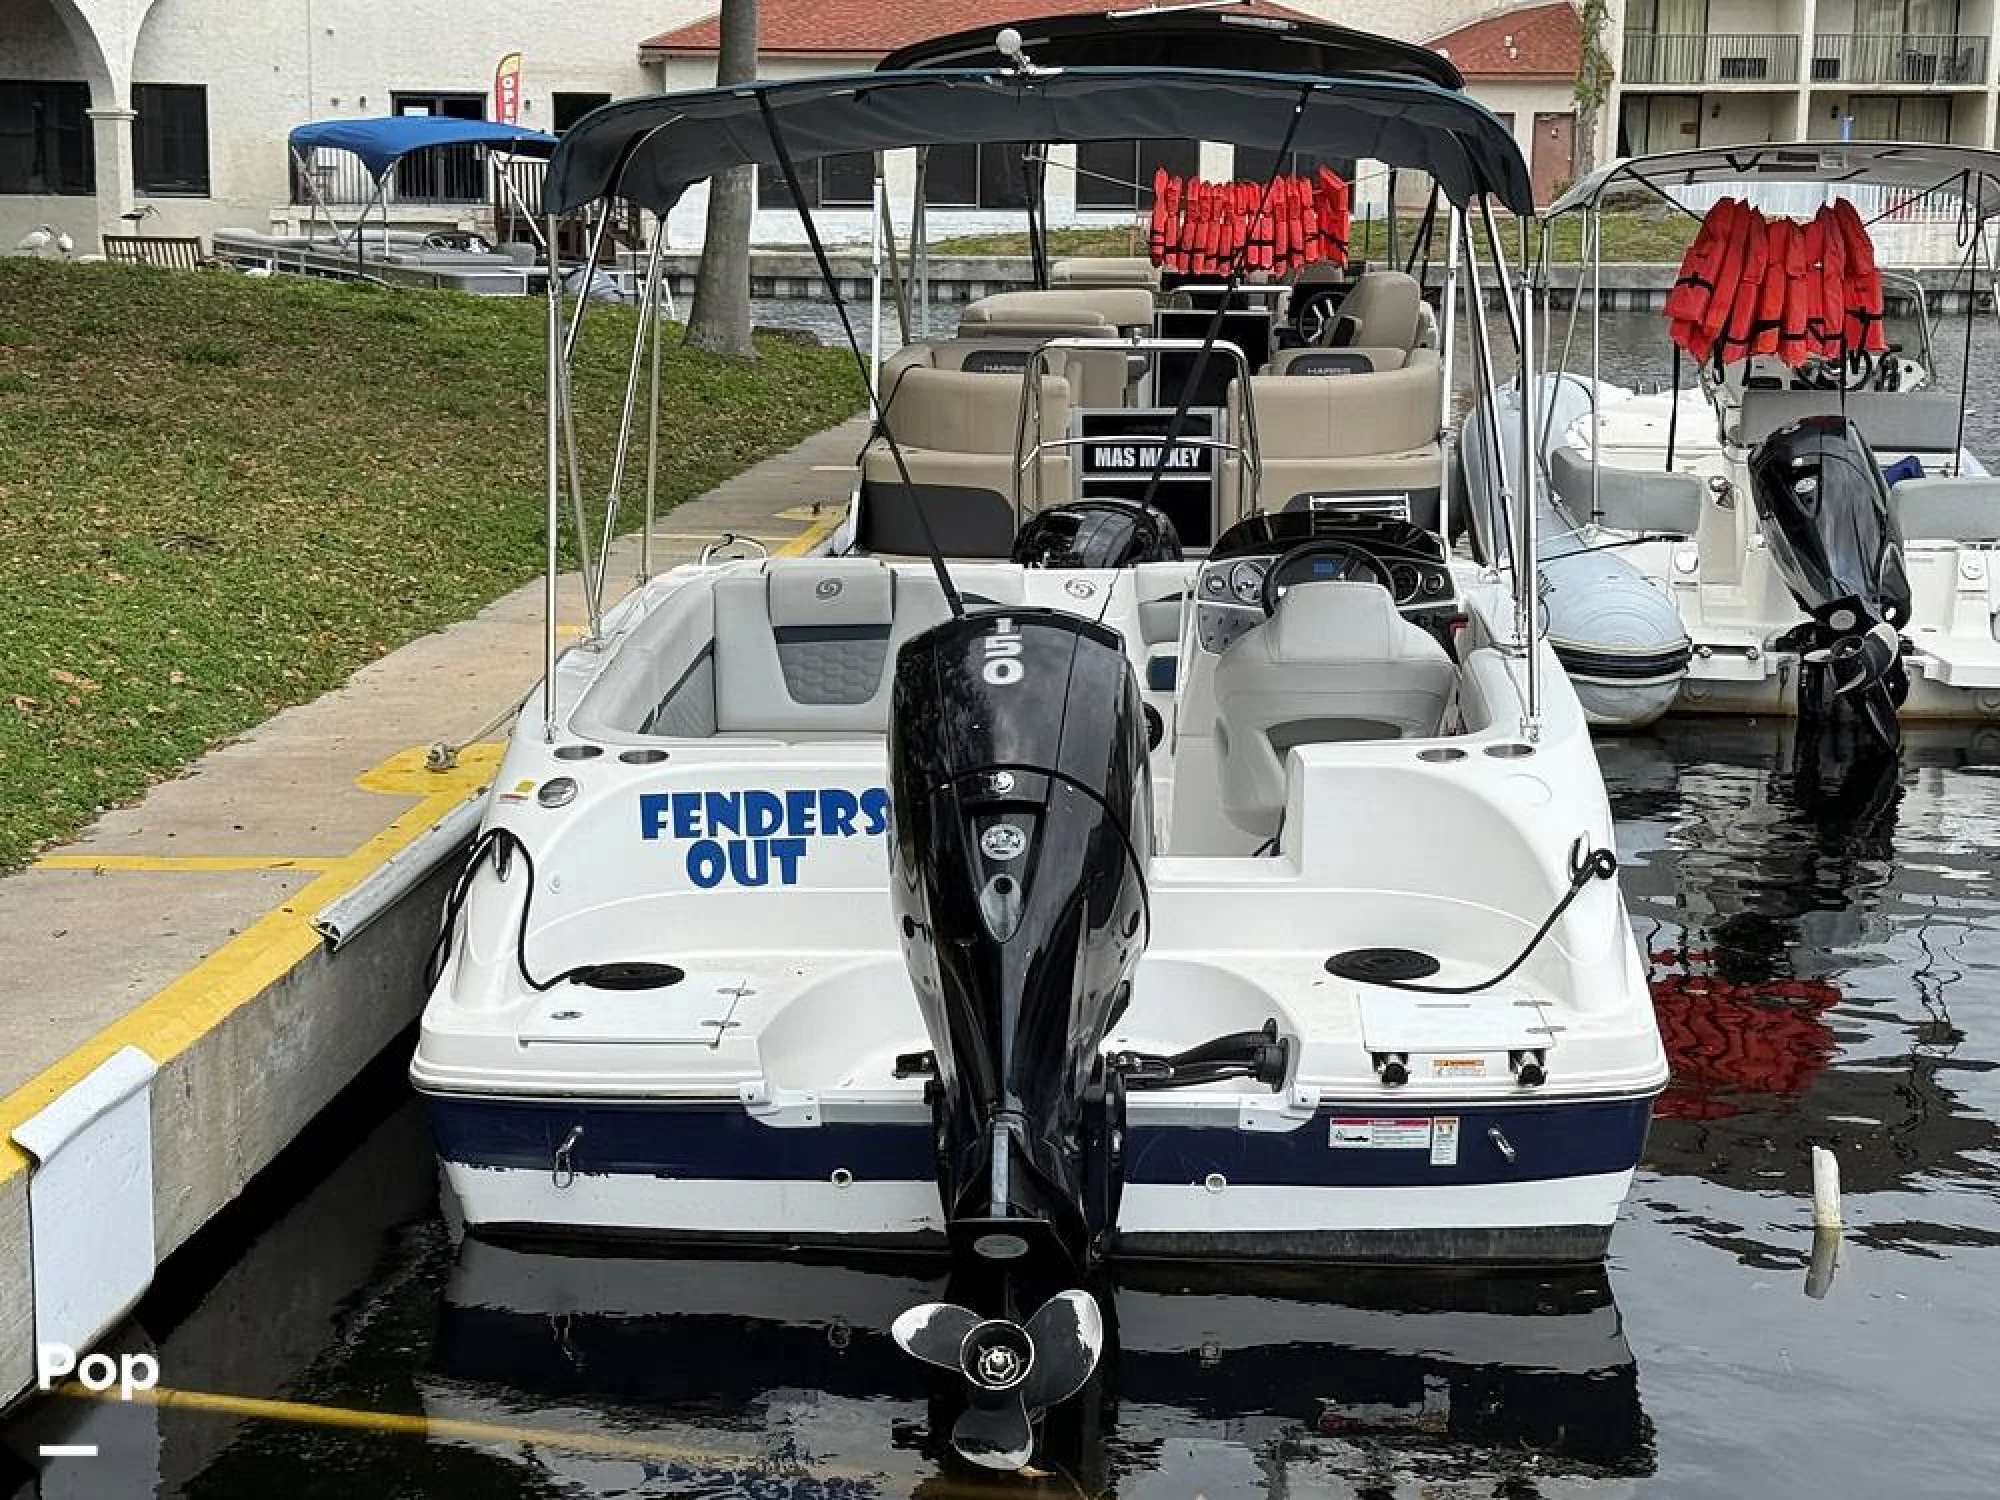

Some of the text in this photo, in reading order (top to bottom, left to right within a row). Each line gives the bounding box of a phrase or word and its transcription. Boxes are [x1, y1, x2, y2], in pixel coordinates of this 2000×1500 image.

[1095, 447, 1136, 467] MAS
[640, 788, 890, 840] FENDERS
[685, 838, 806, 888] OUT
